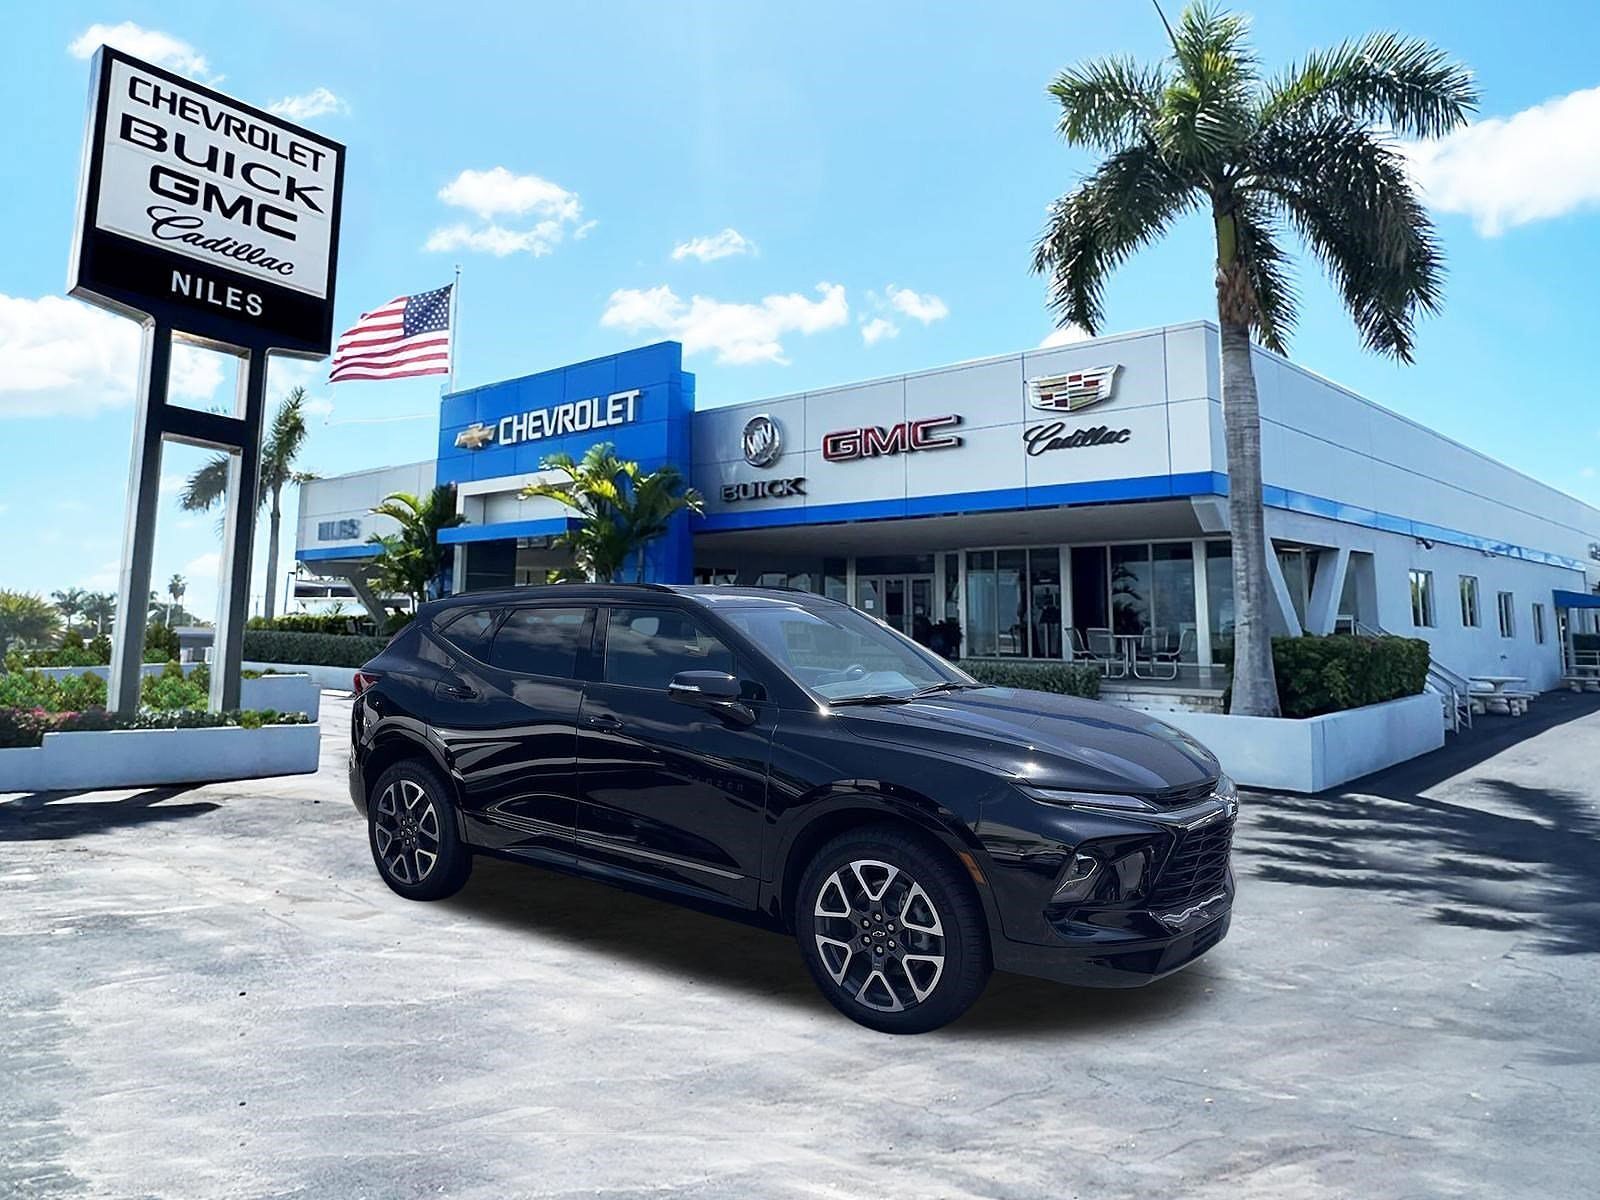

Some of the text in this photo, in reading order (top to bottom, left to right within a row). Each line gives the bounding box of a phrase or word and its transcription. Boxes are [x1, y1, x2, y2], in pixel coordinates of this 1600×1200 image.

[129, 76, 326, 172] CHEVROLET
[120, 113, 324, 214] BUICK
[150, 165, 297, 241] GMC
[146, 206, 294, 275] Cadillac
[171, 270, 263, 316] NILES
[499, 389, 640, 446] CHEVROLET
[822, 414, 963, 462] GMC
[1023, 422, 1132, 457] Cadillac
[720, 477, 807, 502] BUICK
